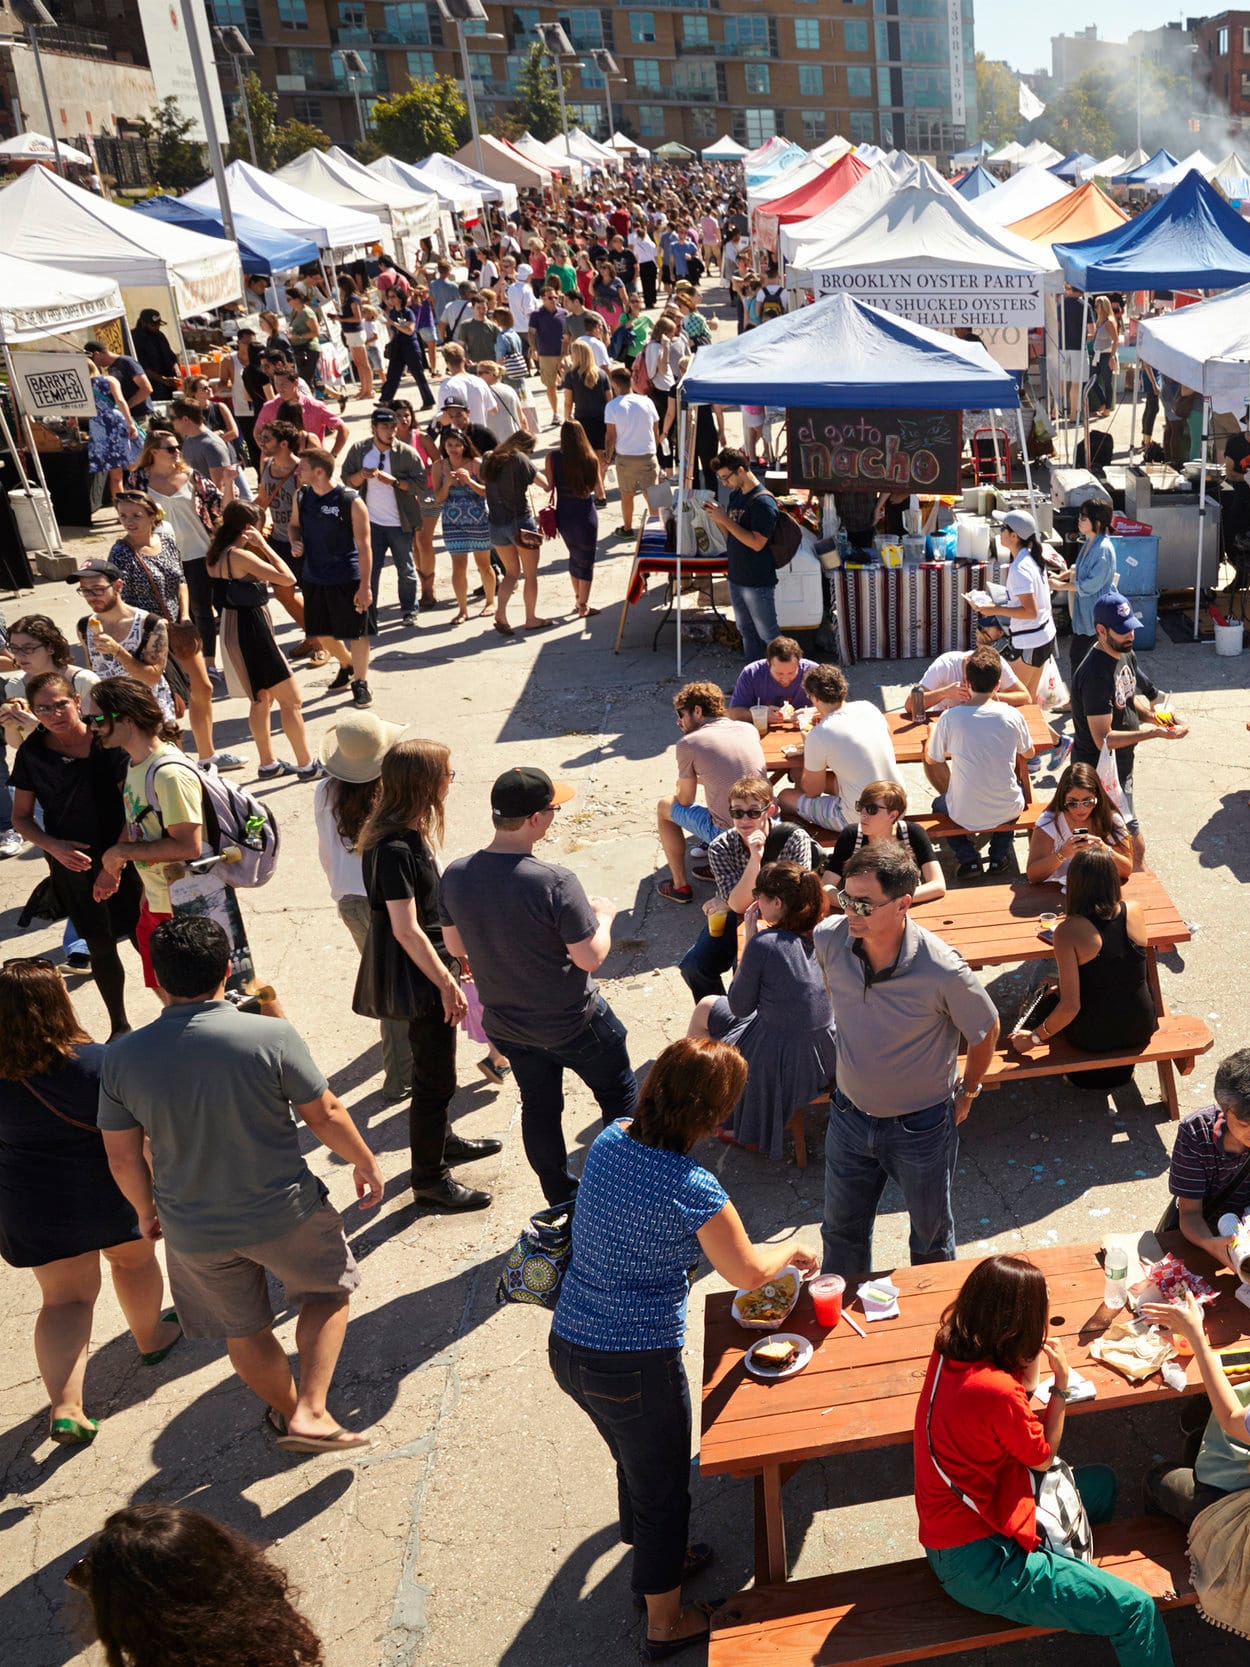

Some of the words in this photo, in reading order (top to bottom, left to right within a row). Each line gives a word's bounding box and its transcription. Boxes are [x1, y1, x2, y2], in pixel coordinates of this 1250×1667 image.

[821, 273, 912, 289] BROOKLYN
[917, 273, 979, 289] OYSTER
[984, 273, 1038, 289] PARTY
[895, 298, 968, 311] SHUCKED
[971, 298, 1037, 311] OYSTERS
[917, 312, 957, 325] HALF
[961, 312, 1008, 325] SHELL
[29, 372, 77, 391] BARRY'S
[35, 386, 83, 405] TEMPEH
[798, 417, 816, 442] el
[824, 415, 882, 446] gato
[799, 434, 940, 485] nacho
